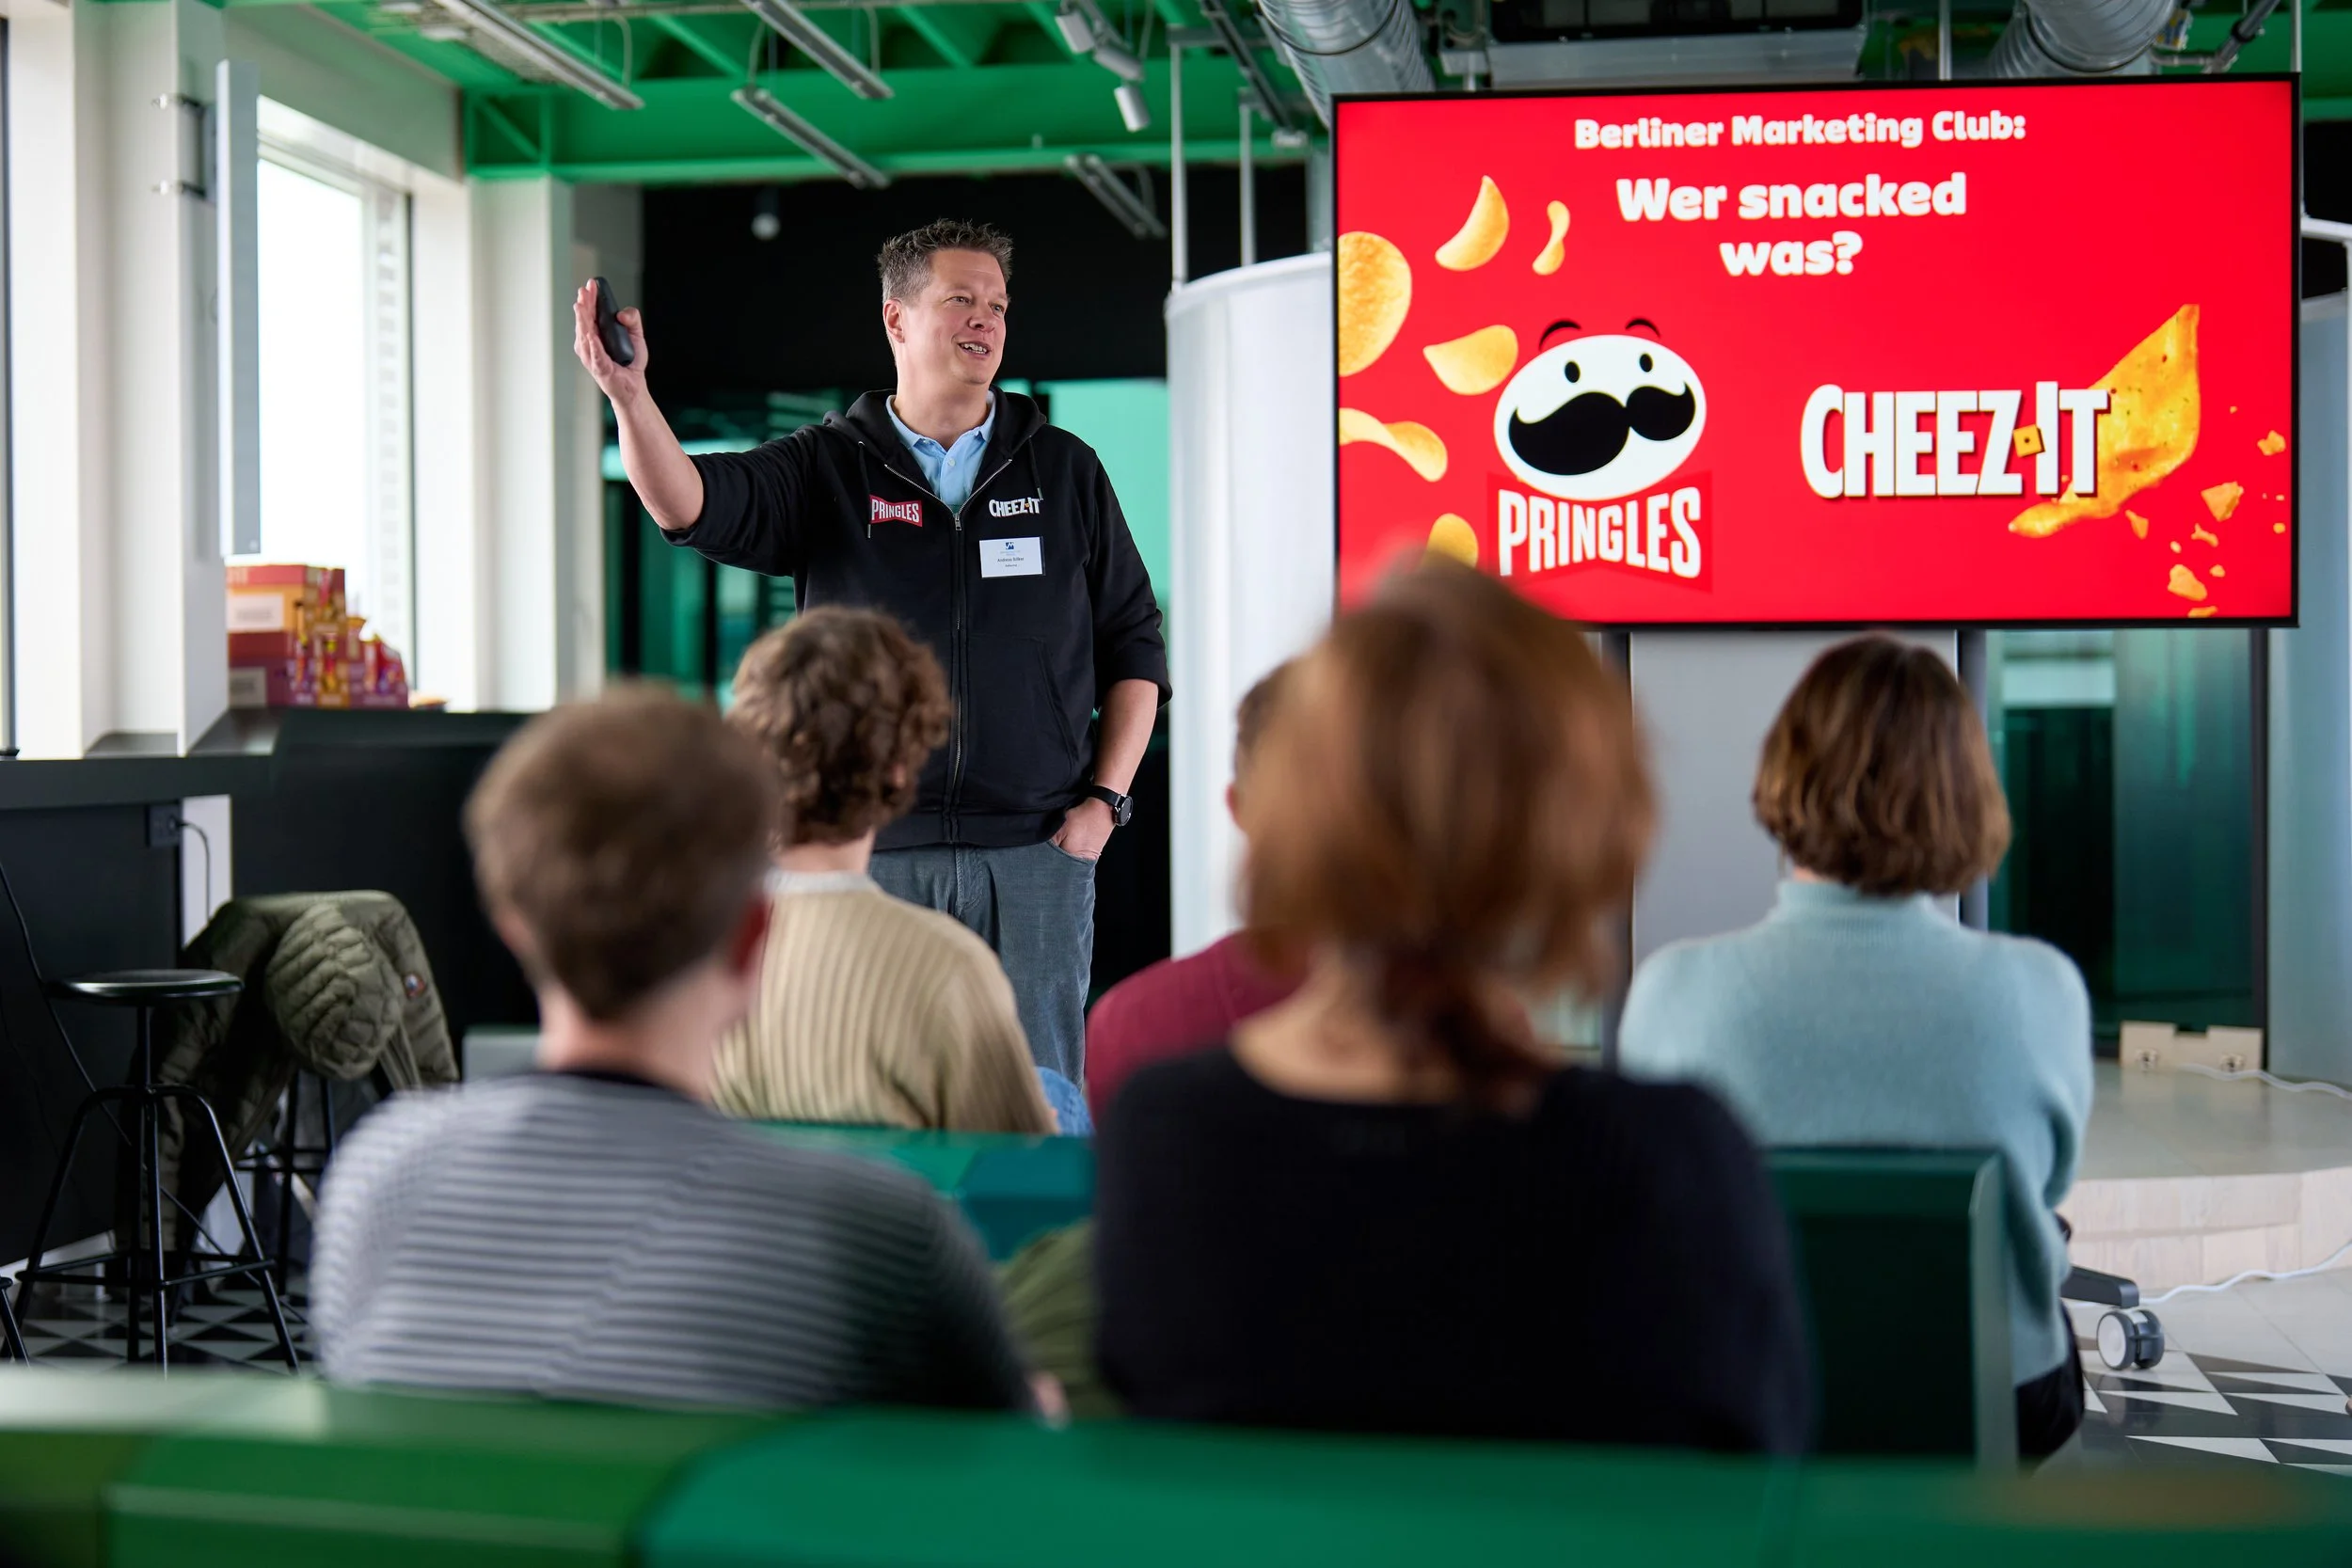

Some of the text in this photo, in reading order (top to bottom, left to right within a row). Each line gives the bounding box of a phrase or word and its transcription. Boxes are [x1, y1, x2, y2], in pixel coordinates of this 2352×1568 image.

[1575, 109, 2026, 149] Berliner Marketing Club:
[1615, 171, 1966, 222] Wer snacked
[1719, 230, 1864, 277] was?
[871, 499, 920, 523] PRINGLES
[1499, 485, 1702, 579] PRINGLES
